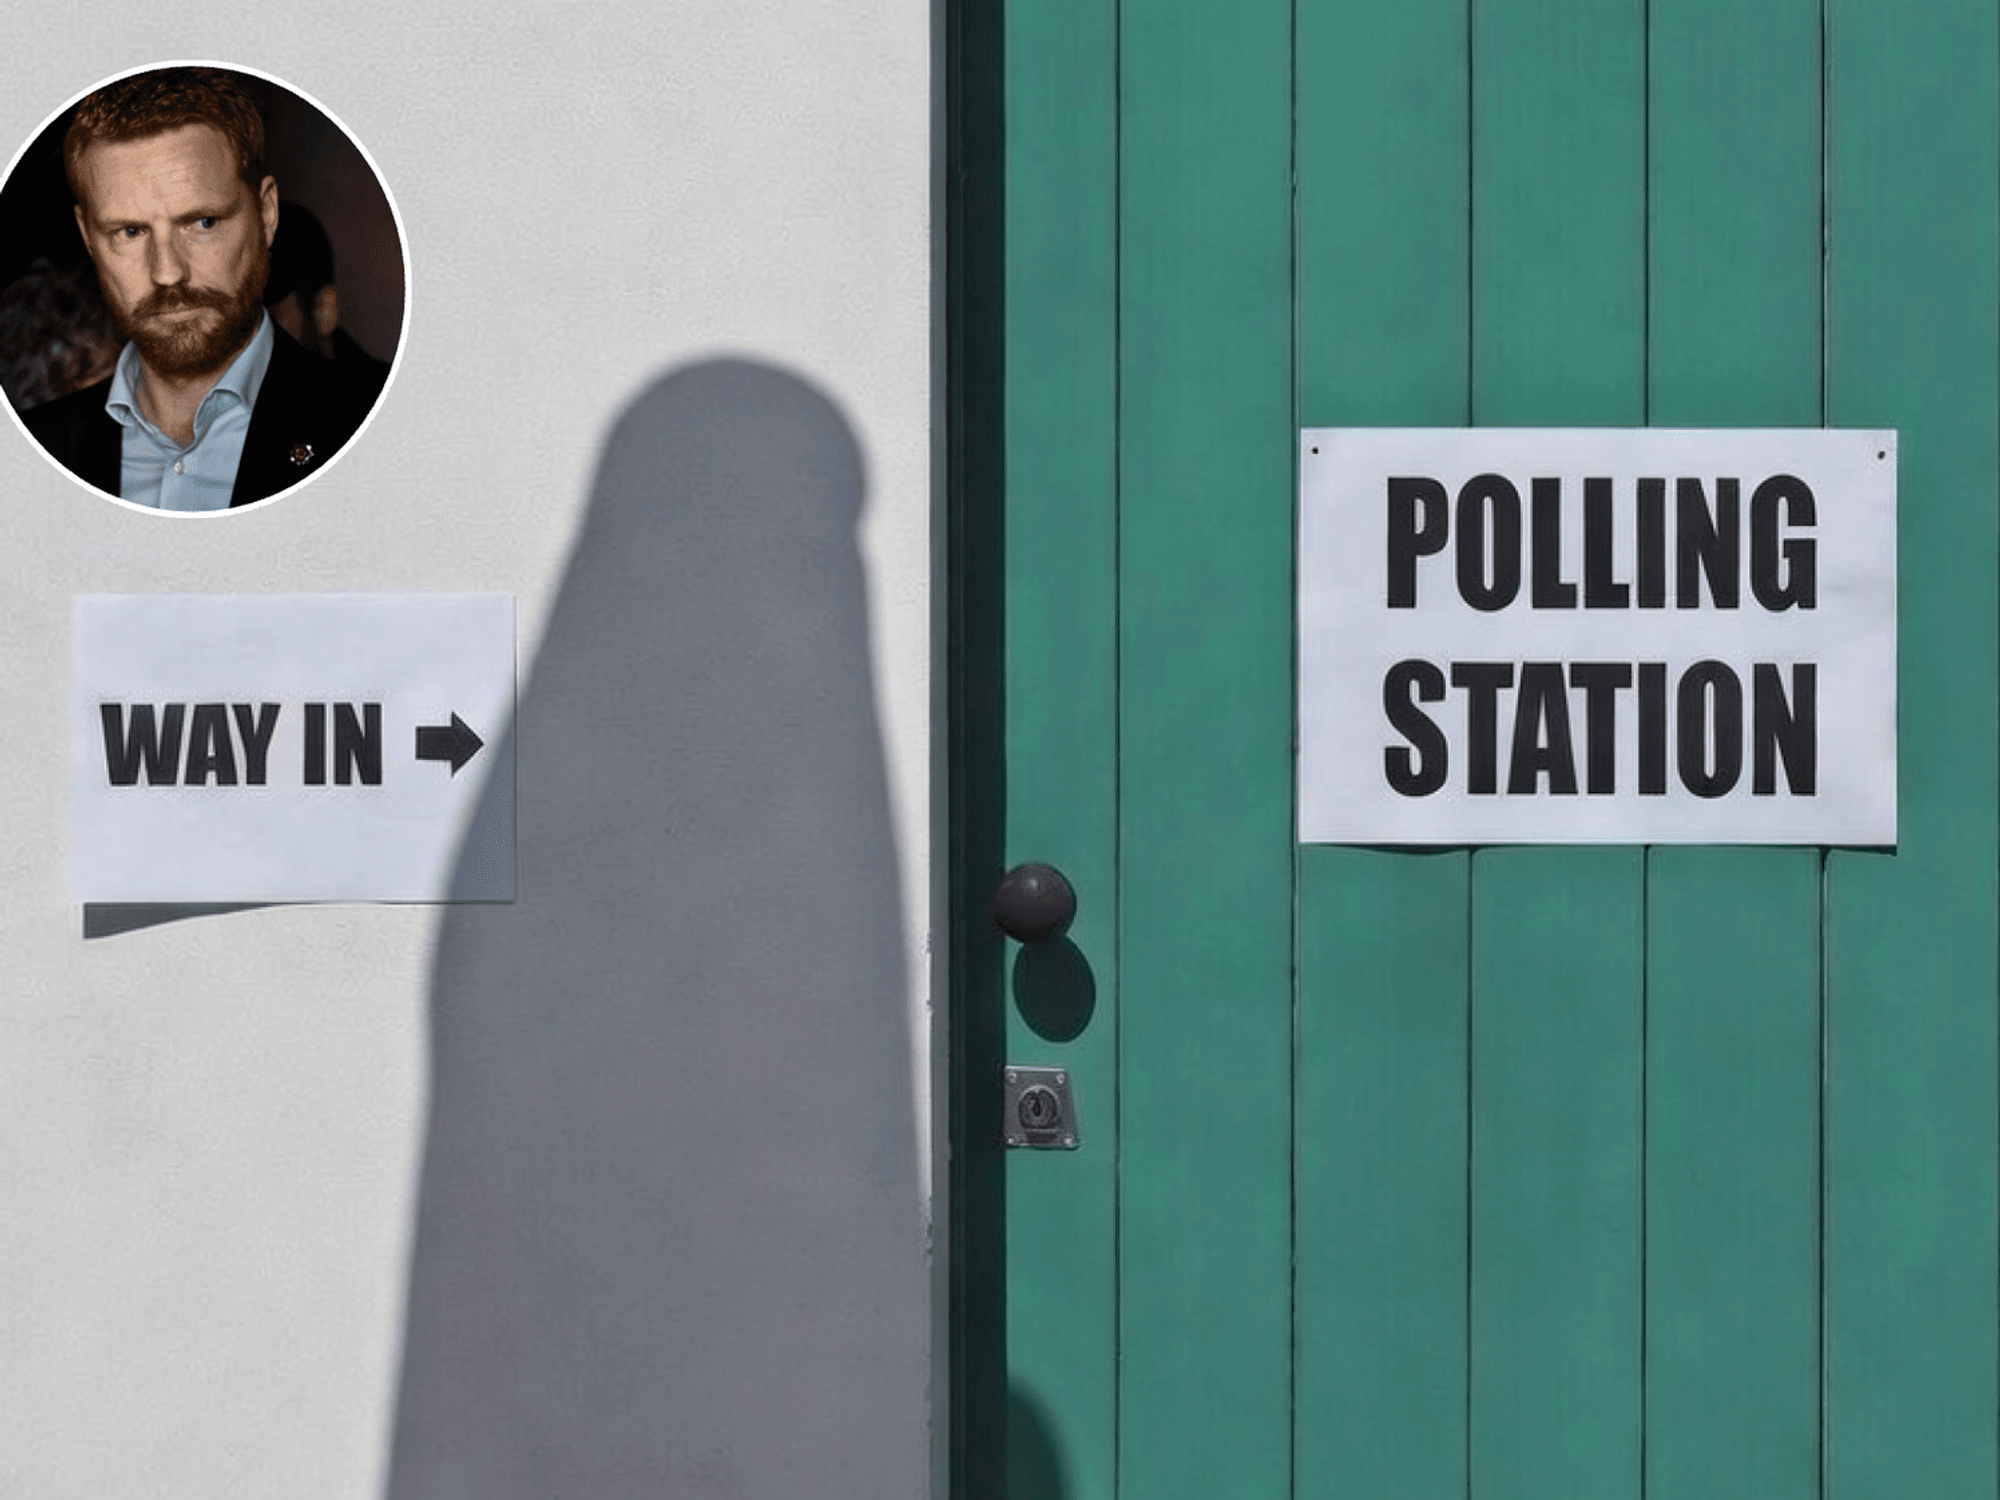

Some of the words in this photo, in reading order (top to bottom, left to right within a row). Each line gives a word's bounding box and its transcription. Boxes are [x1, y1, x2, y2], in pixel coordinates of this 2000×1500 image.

[1387, 474, 1817, 612] POLLING
[100, 703, 281, 786] WAY
[304, 703, 382, 786] IN
[1383, 660, 1817, 798] STATION
